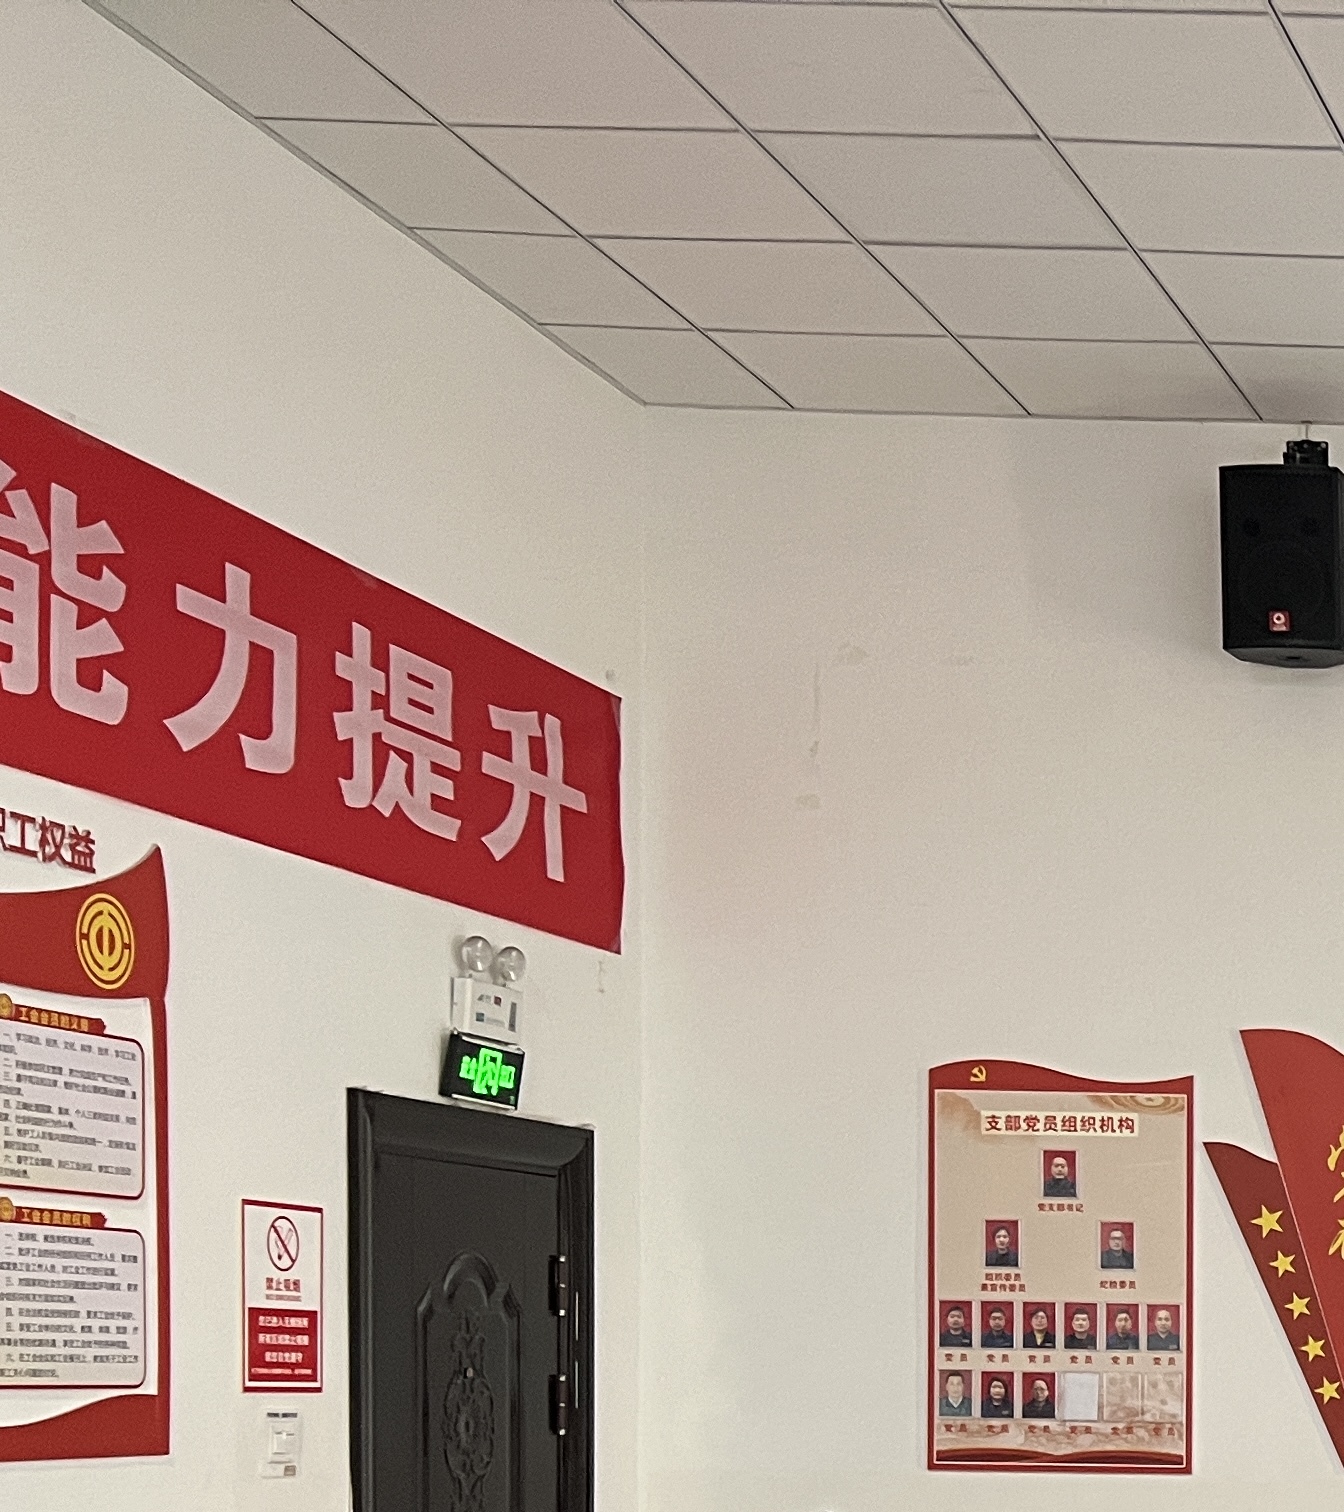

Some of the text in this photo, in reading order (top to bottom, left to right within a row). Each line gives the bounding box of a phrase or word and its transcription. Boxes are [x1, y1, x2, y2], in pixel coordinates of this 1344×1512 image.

[0, 459, 589, 883] 能力提升
[985, 1115, 1135, 1133] 支部党员组织机构
